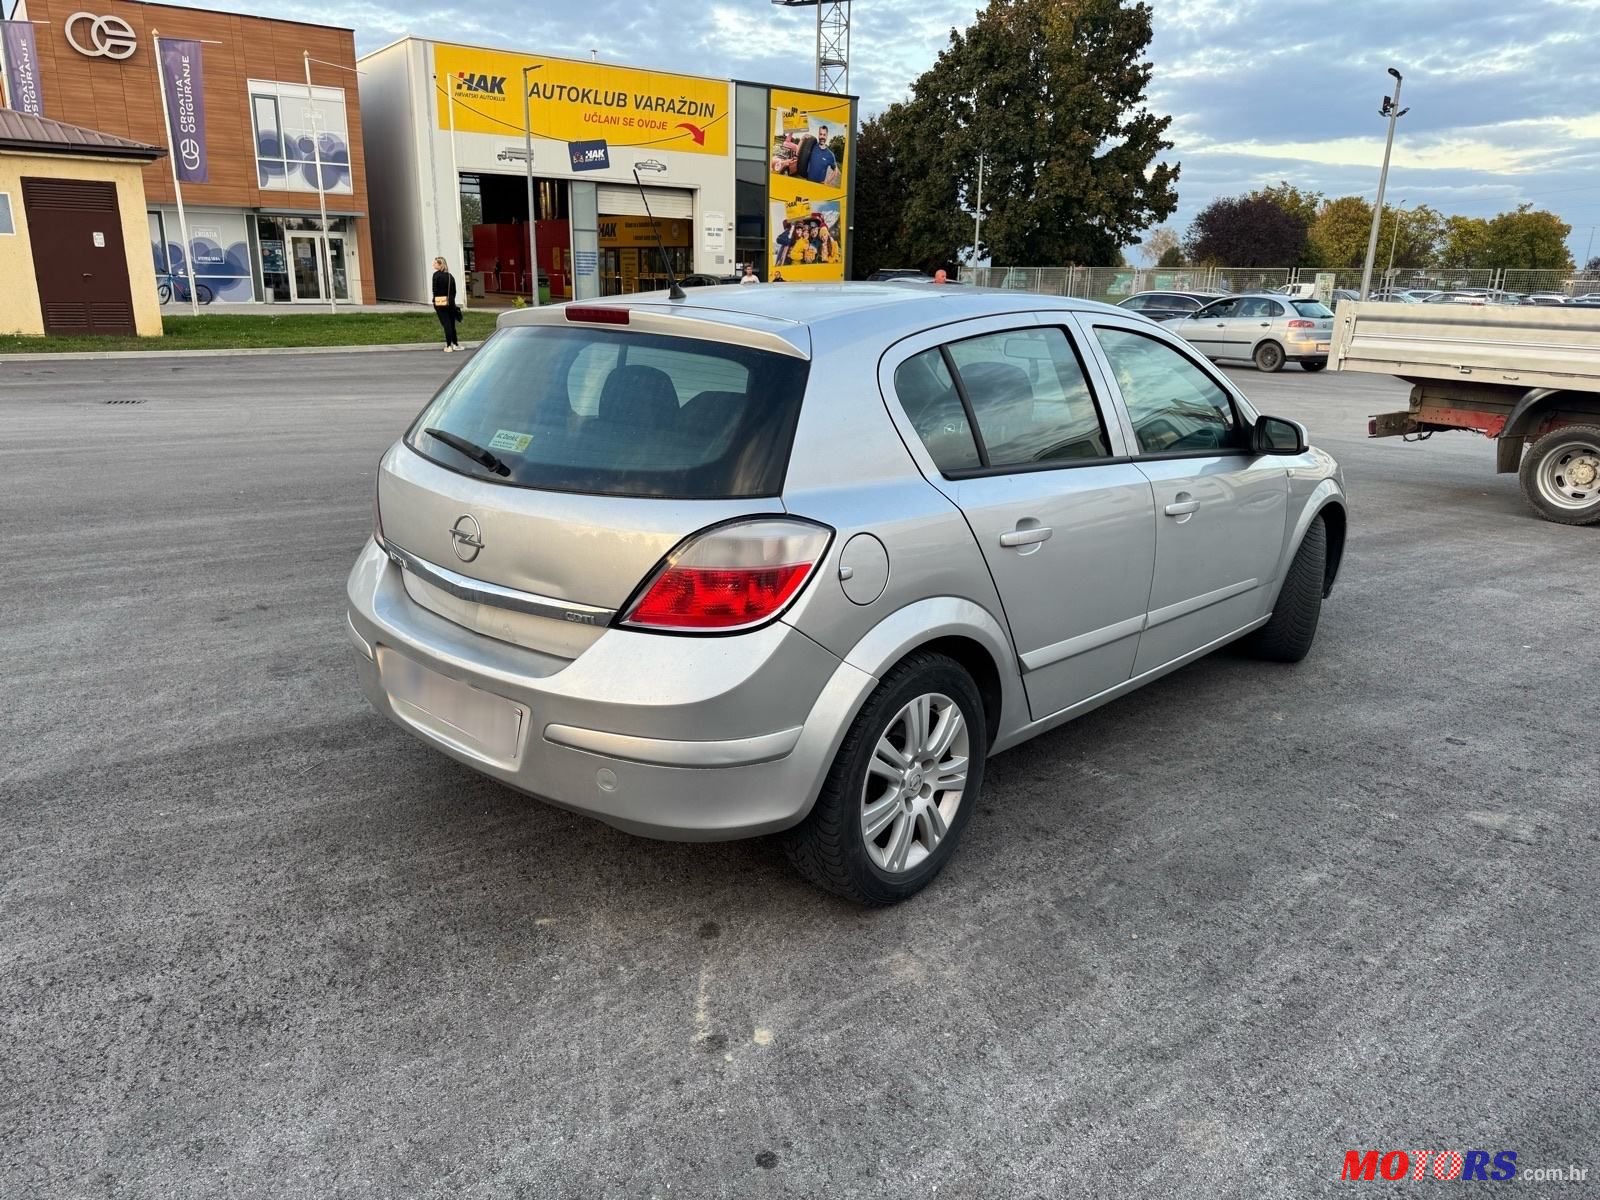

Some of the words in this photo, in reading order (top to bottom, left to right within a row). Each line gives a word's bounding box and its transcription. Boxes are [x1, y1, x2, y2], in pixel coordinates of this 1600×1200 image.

[18, 64, 32, 112] ROATIA
[181, 55, 196, 133] OSIGURANJE
[456, 72, 507, 95] HAK
[479, 94, 506, 102] AUTOKLUB
[175, 79, 188, 133] CROATIA
[528, 82, 628, 108] AUTOKLUB
[634, 94, 716, 118] VARAŽDIN
[583, 112, 620, 126] UČLANI
[622, 116, 635, 127] SE
[637, 118, 668, 131] OVDJE
[585, 148, 605, 159] HAK
